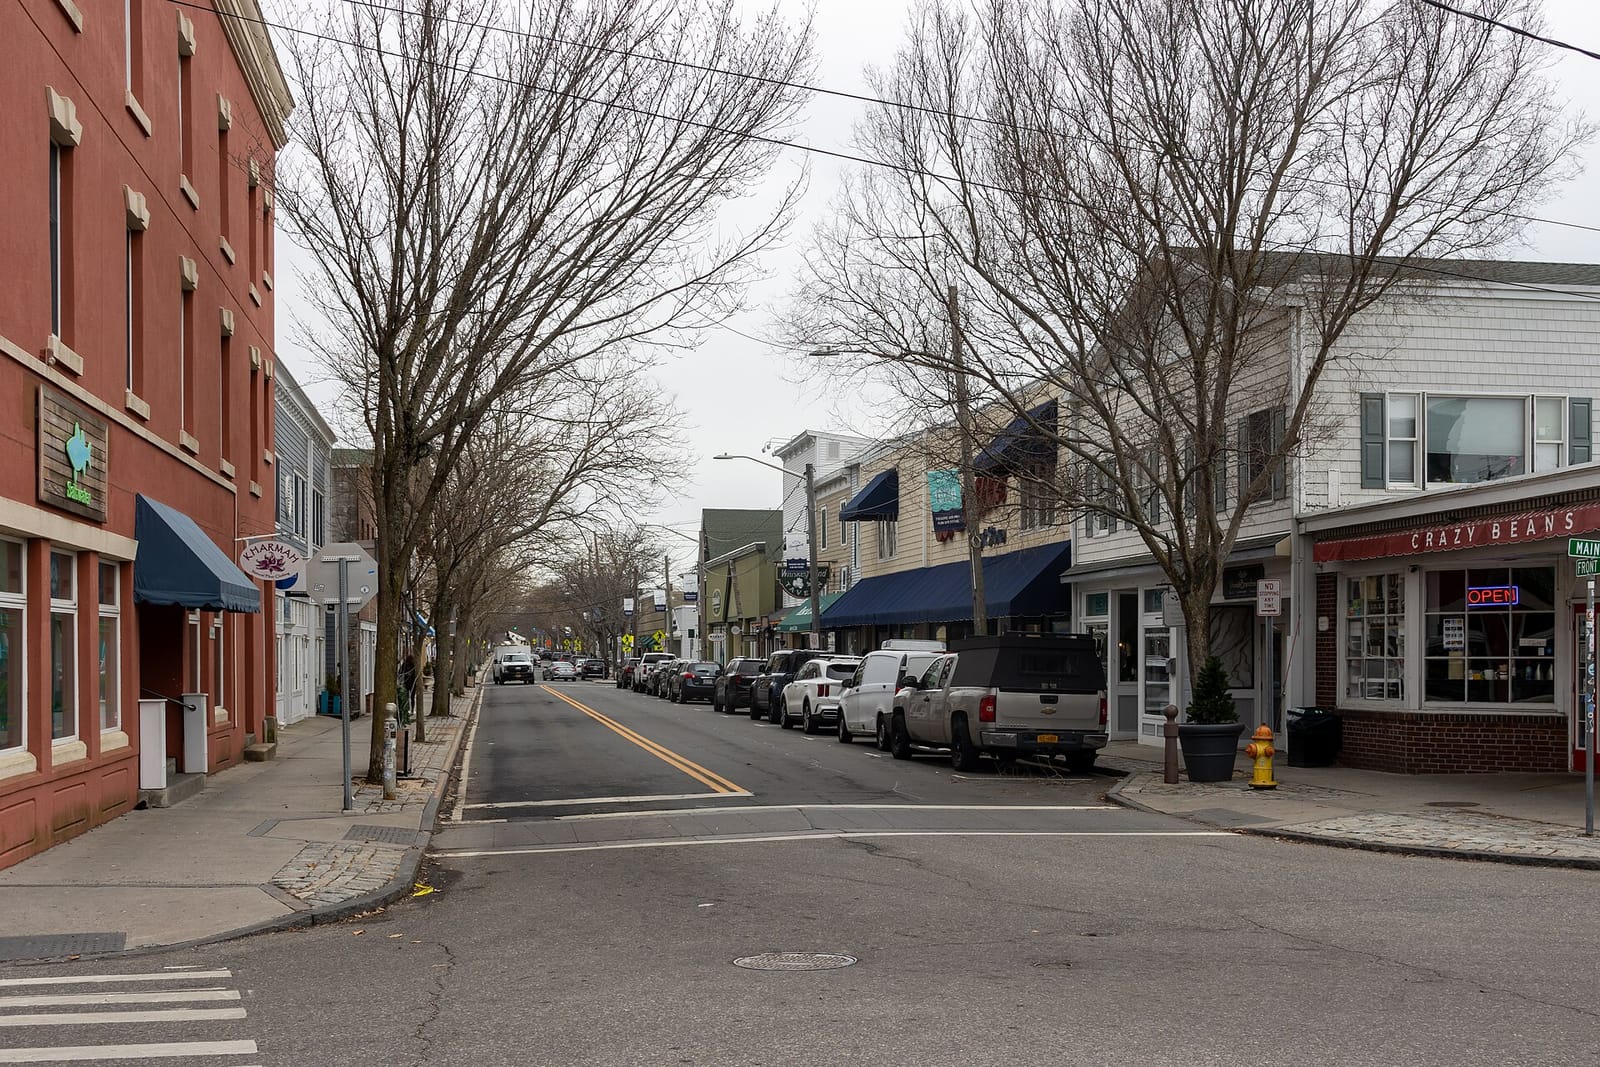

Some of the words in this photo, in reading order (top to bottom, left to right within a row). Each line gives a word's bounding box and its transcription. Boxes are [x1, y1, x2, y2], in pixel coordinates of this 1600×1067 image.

[1411, 525, 1475, 549] CRAZY
[1492, 512, 1574, 540] BEANS
[243, 544, 299, 563] KHARMAH
[1576, 541, 1600, 556] MAIN
[1577, 560, 1598, 575] FRONT
[1468, 589, 1516, 604] OPEN
